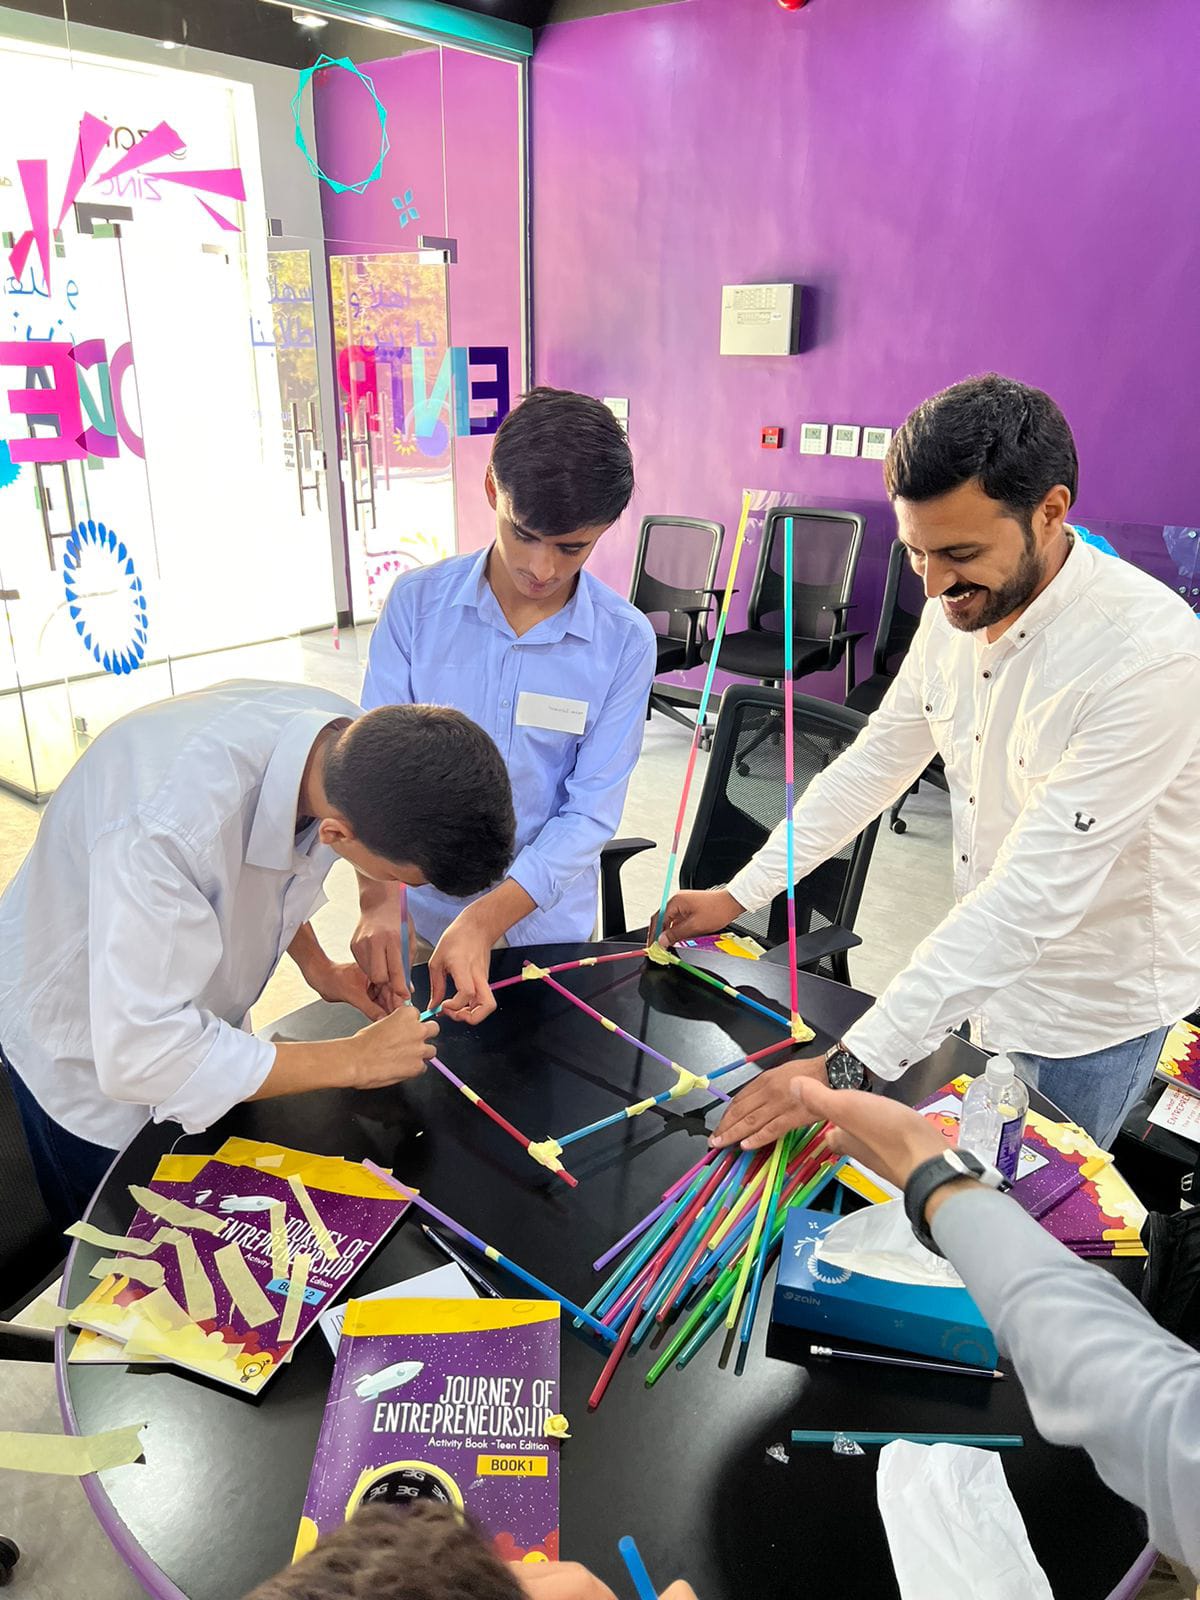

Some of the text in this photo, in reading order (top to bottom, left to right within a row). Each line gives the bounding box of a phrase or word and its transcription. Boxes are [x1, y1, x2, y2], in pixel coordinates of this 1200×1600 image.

[342, 1239, 372, 1260] OF
[244, 1254, 333, 1289] Activity Edition
[440, 1376, 556, 1408] JOURNEY OF
[428, 1436, 463, 1450] Activity
[465, 1437, 488, 1449] Book
[519, 1440, 549, 1451] Edition
